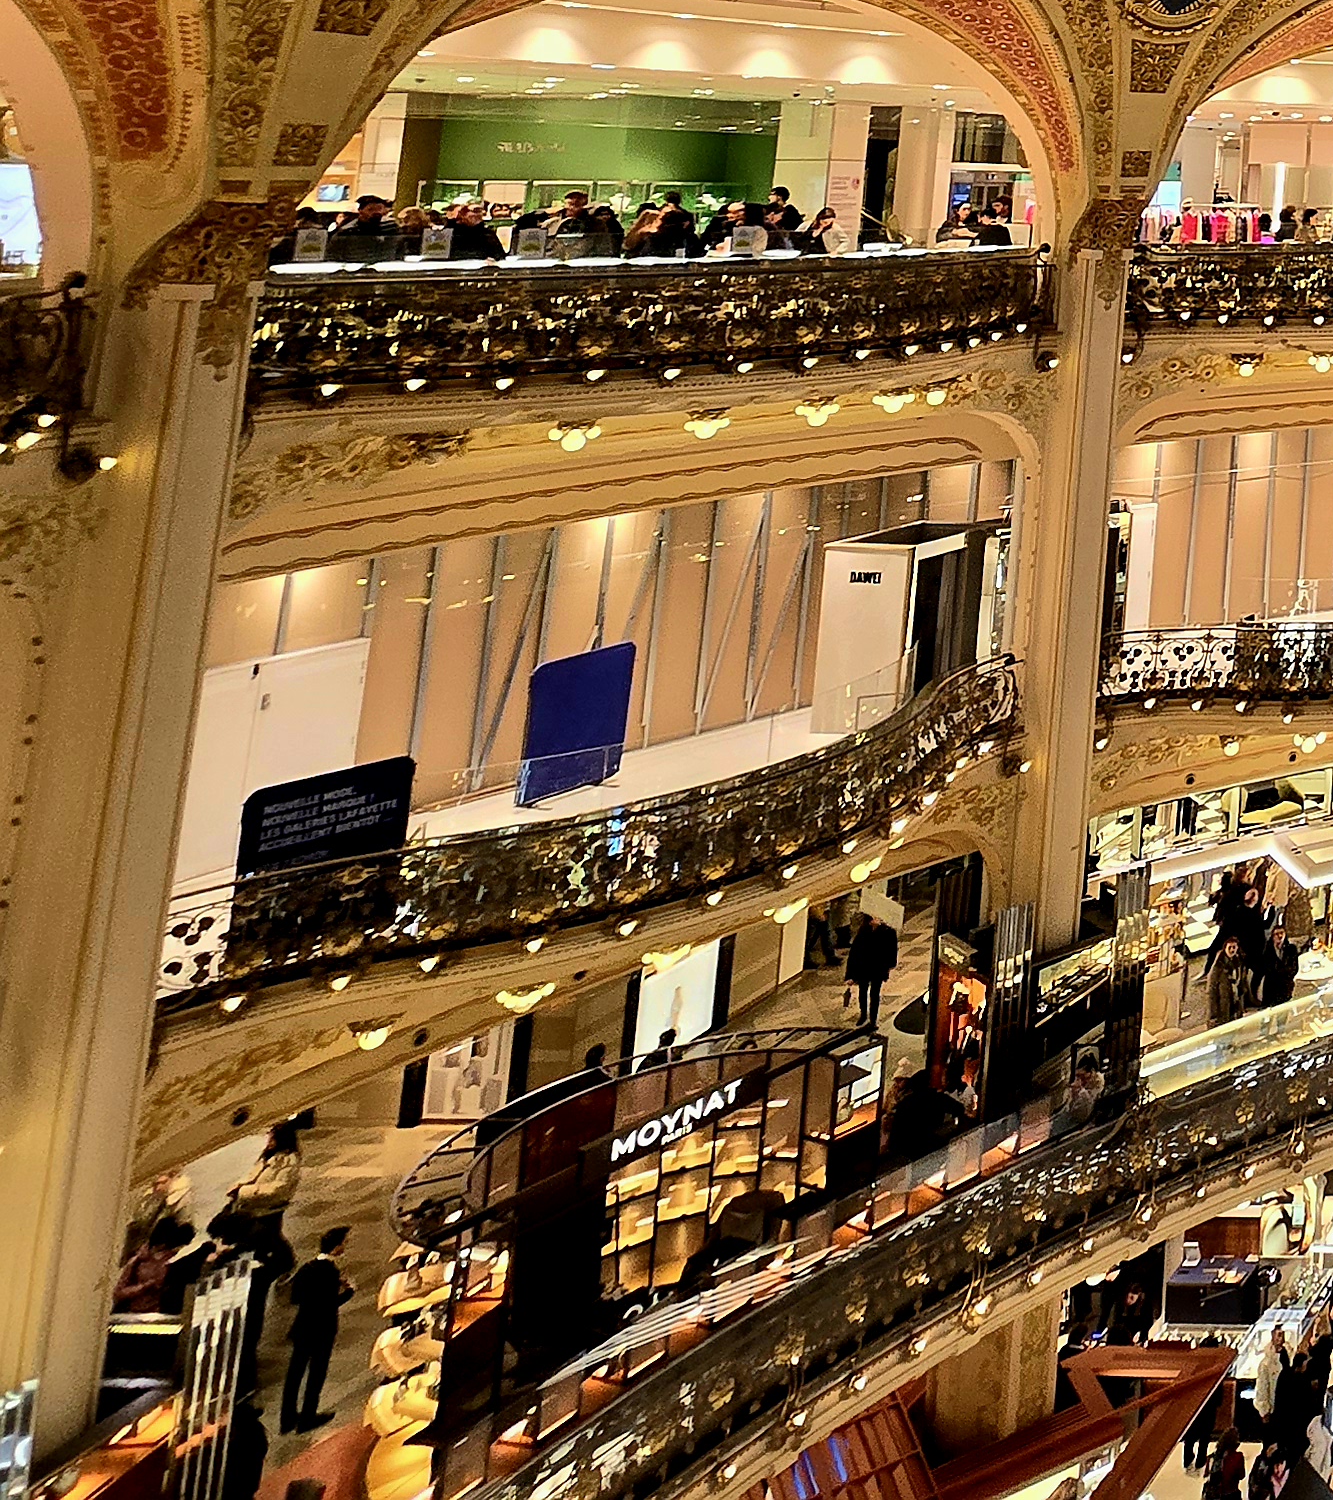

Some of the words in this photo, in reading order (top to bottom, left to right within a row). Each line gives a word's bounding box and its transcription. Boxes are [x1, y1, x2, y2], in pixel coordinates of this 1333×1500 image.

[260, 827, 281, 841] LES
[283, 814, 336, 835] GALERIES
[339, 798, 398, 821] LAFAYETTE
[610, 1078, 743, 1162] MOYNAT
